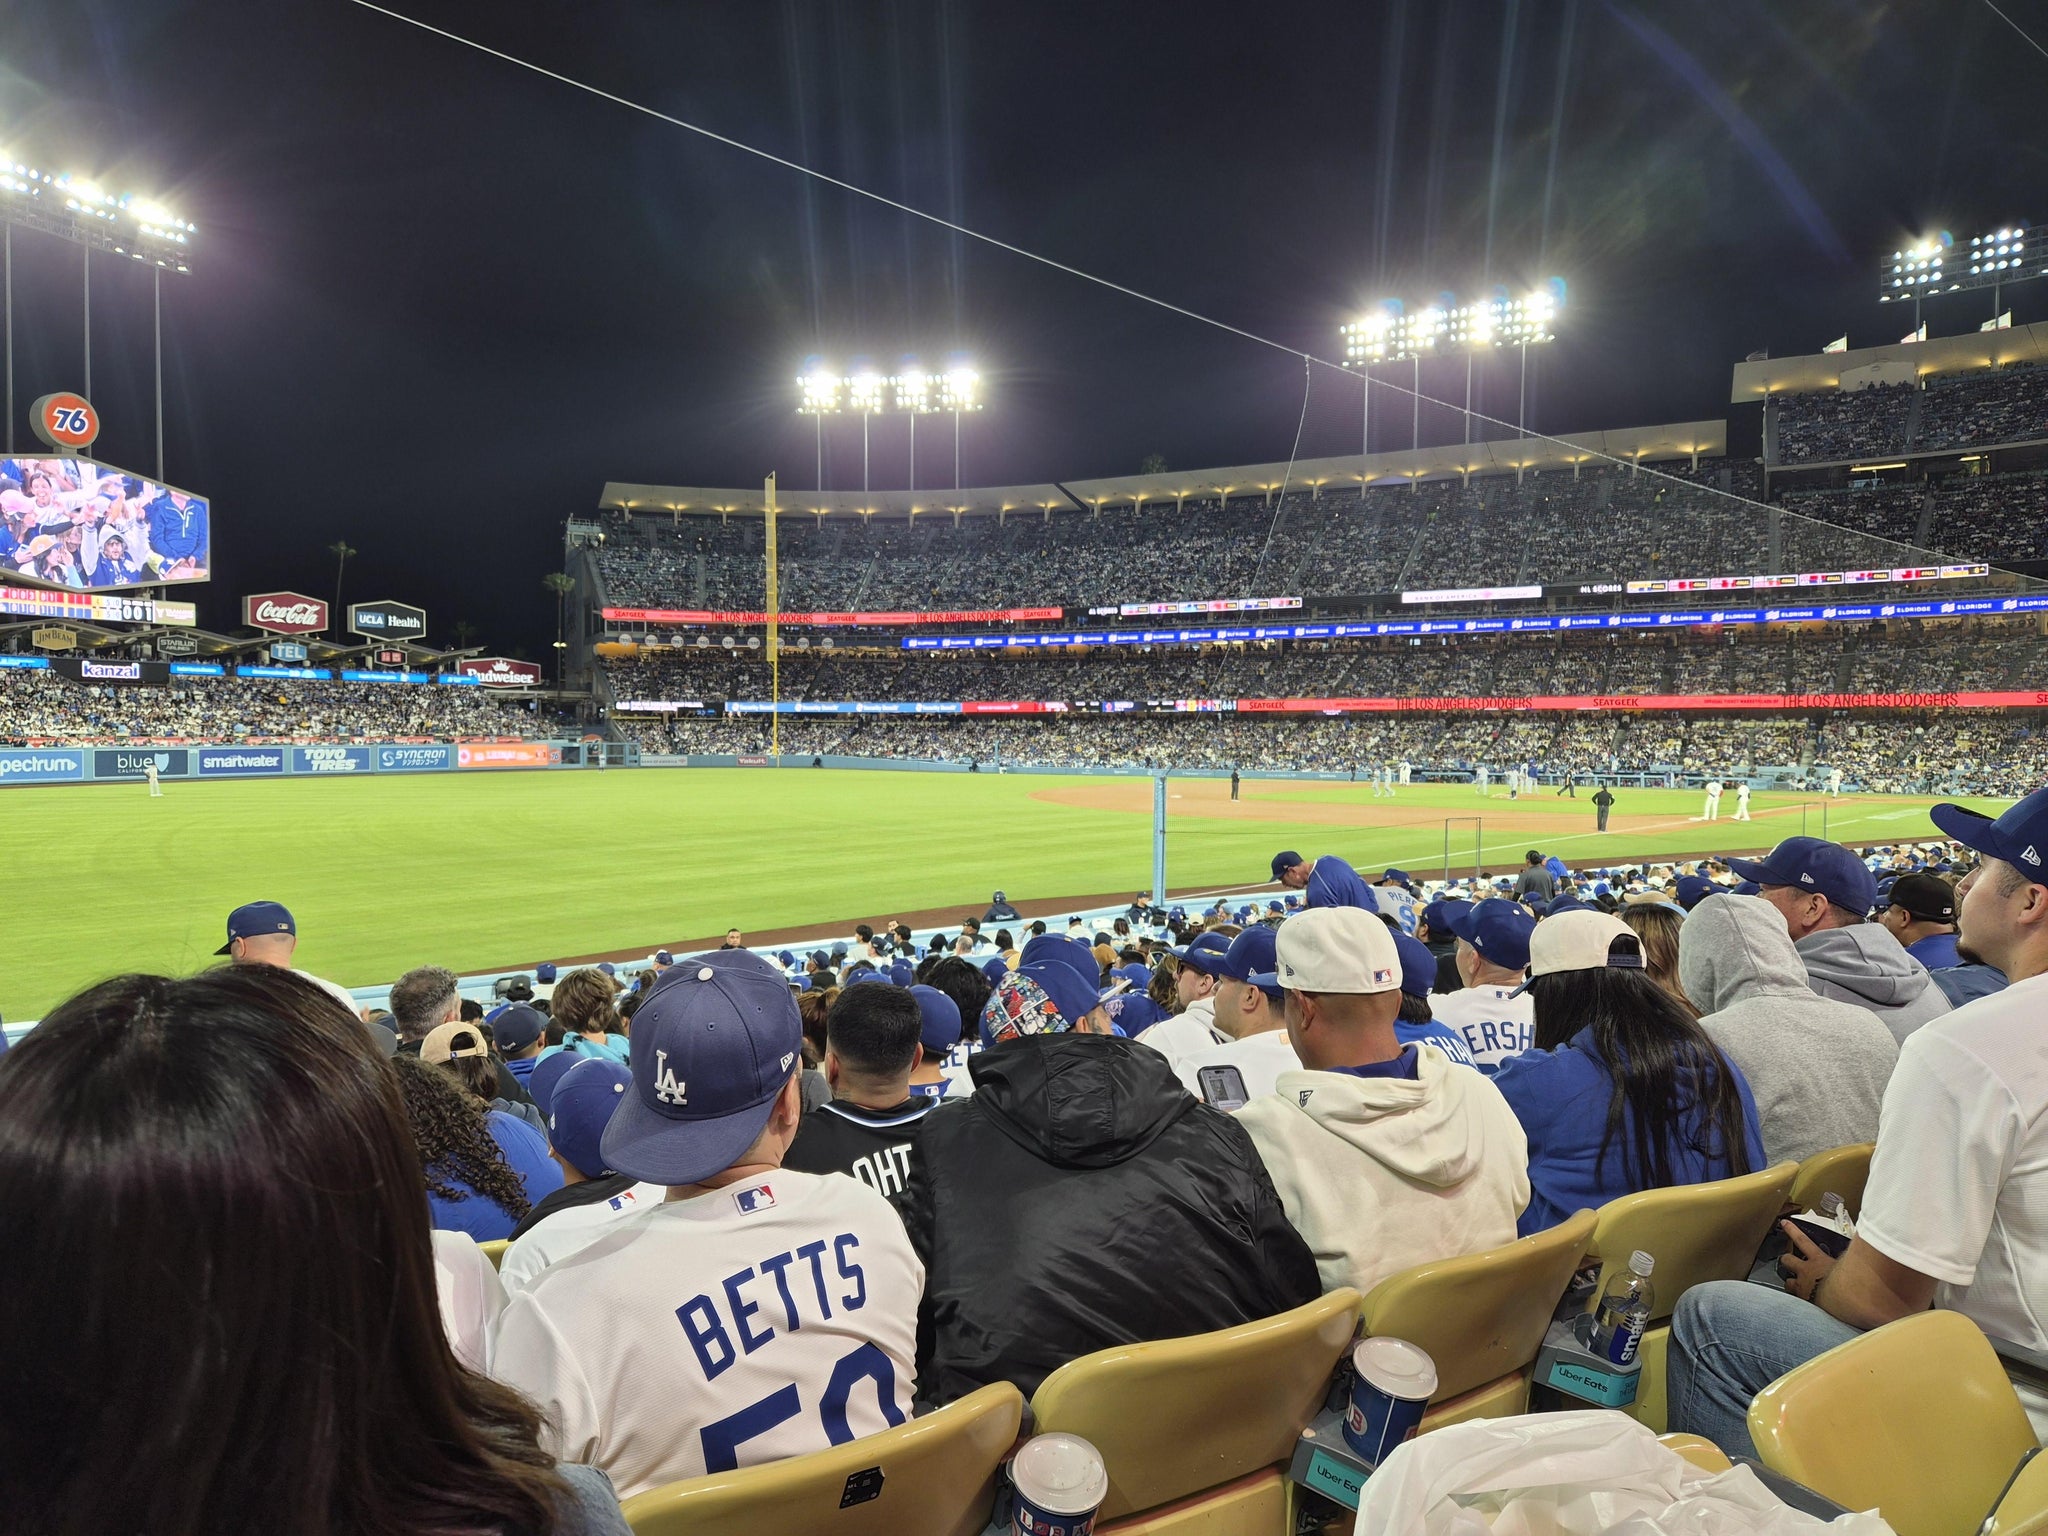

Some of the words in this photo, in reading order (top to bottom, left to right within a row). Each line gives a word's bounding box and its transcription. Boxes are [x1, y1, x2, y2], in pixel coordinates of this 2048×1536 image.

[53, 408, 88, 434] 76
[256, 600, 321, 625] Coca-Cola
[1956, 602, 1992, 610] ELDRIDGE
[359, 614, 384, 625] UCLA
[387, 615, 421, 628] Health
[726, 612, 740, 623] LOS
[37, 631, 51, 644] JIM
[52, 630, 72, 645] BEAM
[160, 639, 195, 647] STARLUX
[276, 645, 302, 658] TEL
[1397, 698, 1414, 709] THE
[1415, 698, 1434, 709] LOS
[1435, 697, 1481, 709] ANGELES
[1481, 696, 1532, 709] DODGERS
[1593, 698, 1638, 706] SEATGEEK
[1783, 694, 1803, 707] THE
[1807, 693, 1830, 707] LOS
[1833, 692, 1891, 707] ANGELES
[1893, 691, 1958, 707] DODGERS
[117, 754, 153, 768] blue
[203, 754, 279, 769] smartwater
[304, 749, 347, 760] TOYO
[395, 749, 446, 759] SYNCRON
[551, 752, 559, 760] 76
[0, 756, 71, 777] pectrum
[311, 759, 356, 771] TIRES
[1460, 1020, 1535, 1055] ERSH
[655, 1050, 688, 1106] LA
[852, 1143, 912, 1197] OHT
[675, 1232, 867, 1382] BETTS
[1620, 1311, 1649, 1361] smart
[1557, 1366, 1583, 1383] Uber
[1583, 1377, 1609, 1394] Eats
[1316, 1465, 1344, 1486] Uber
